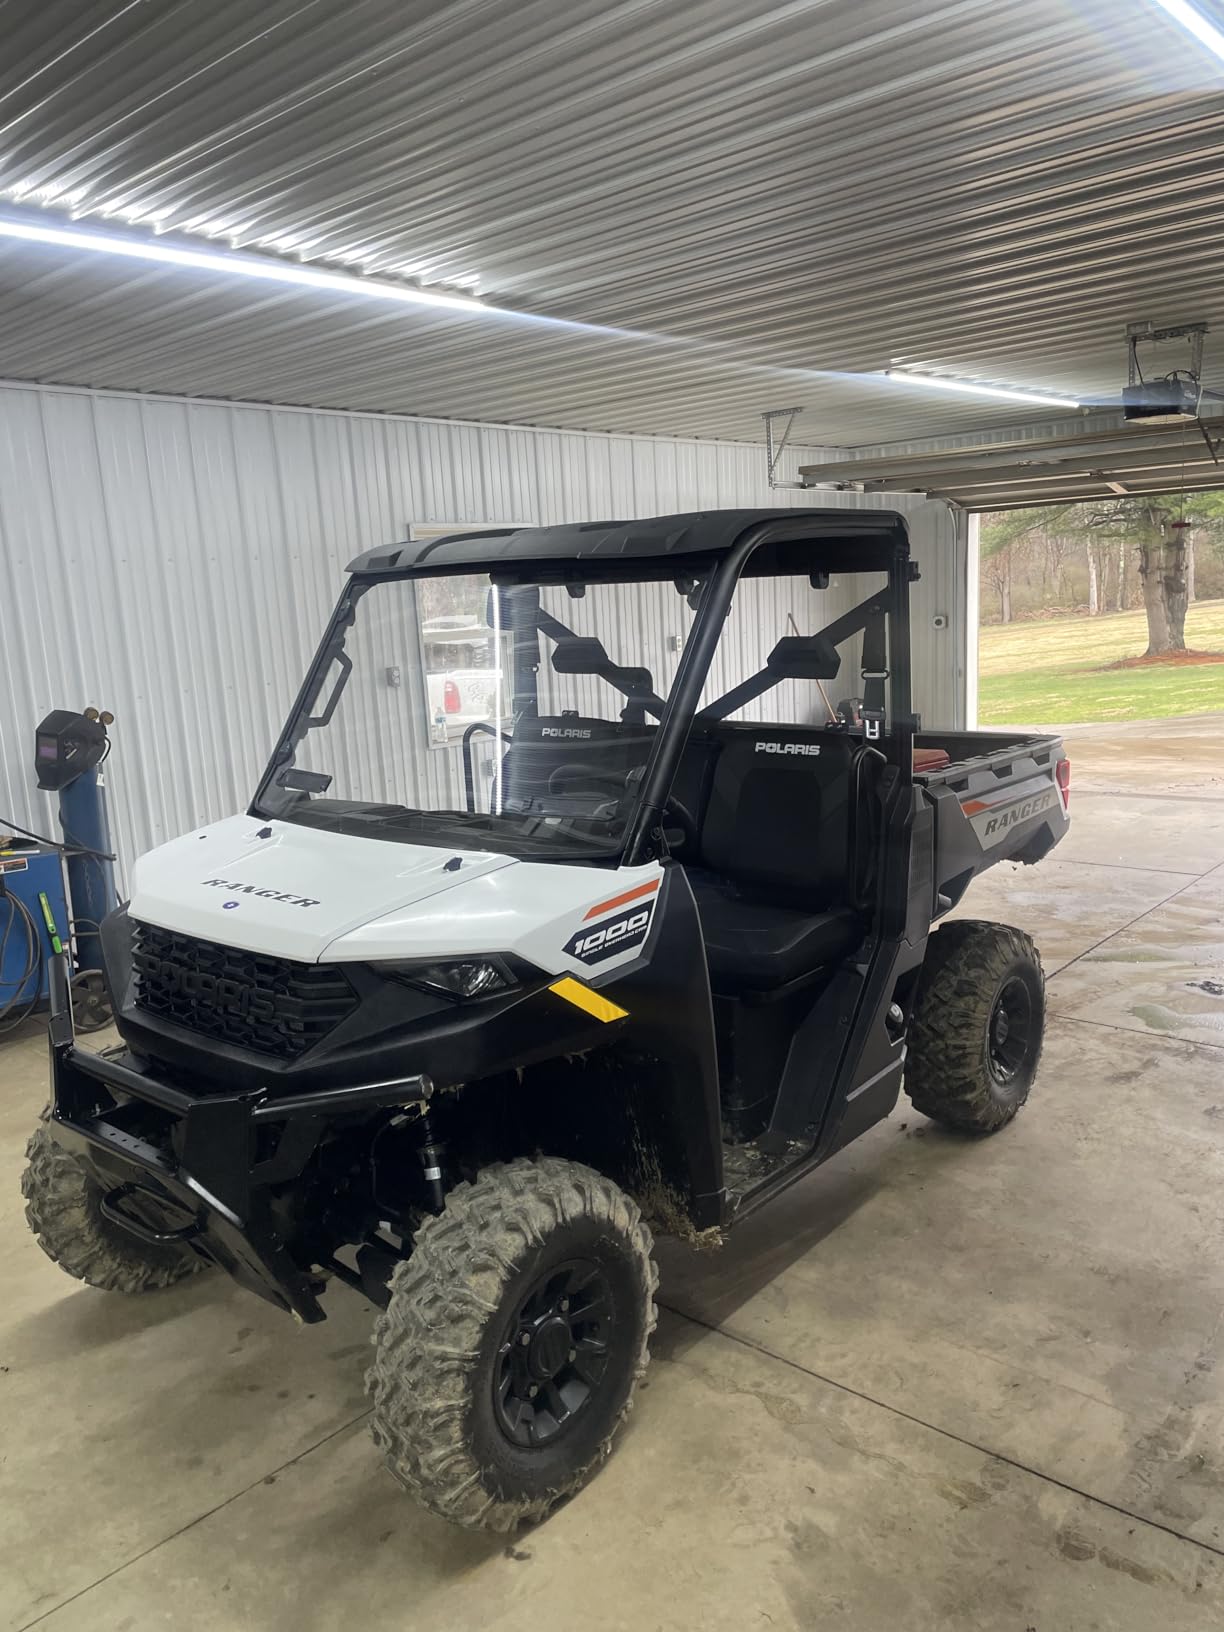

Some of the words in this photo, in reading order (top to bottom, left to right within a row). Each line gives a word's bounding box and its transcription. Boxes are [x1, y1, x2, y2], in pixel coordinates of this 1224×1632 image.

[541, 727, 591, 738] POLARIS
[754, 742, 821, 756] POLARIS
[984, 794, 1051, 836] RANGER
[200, 879, 321, 907] RANGER
[574, 910, 649, 955] 1000
